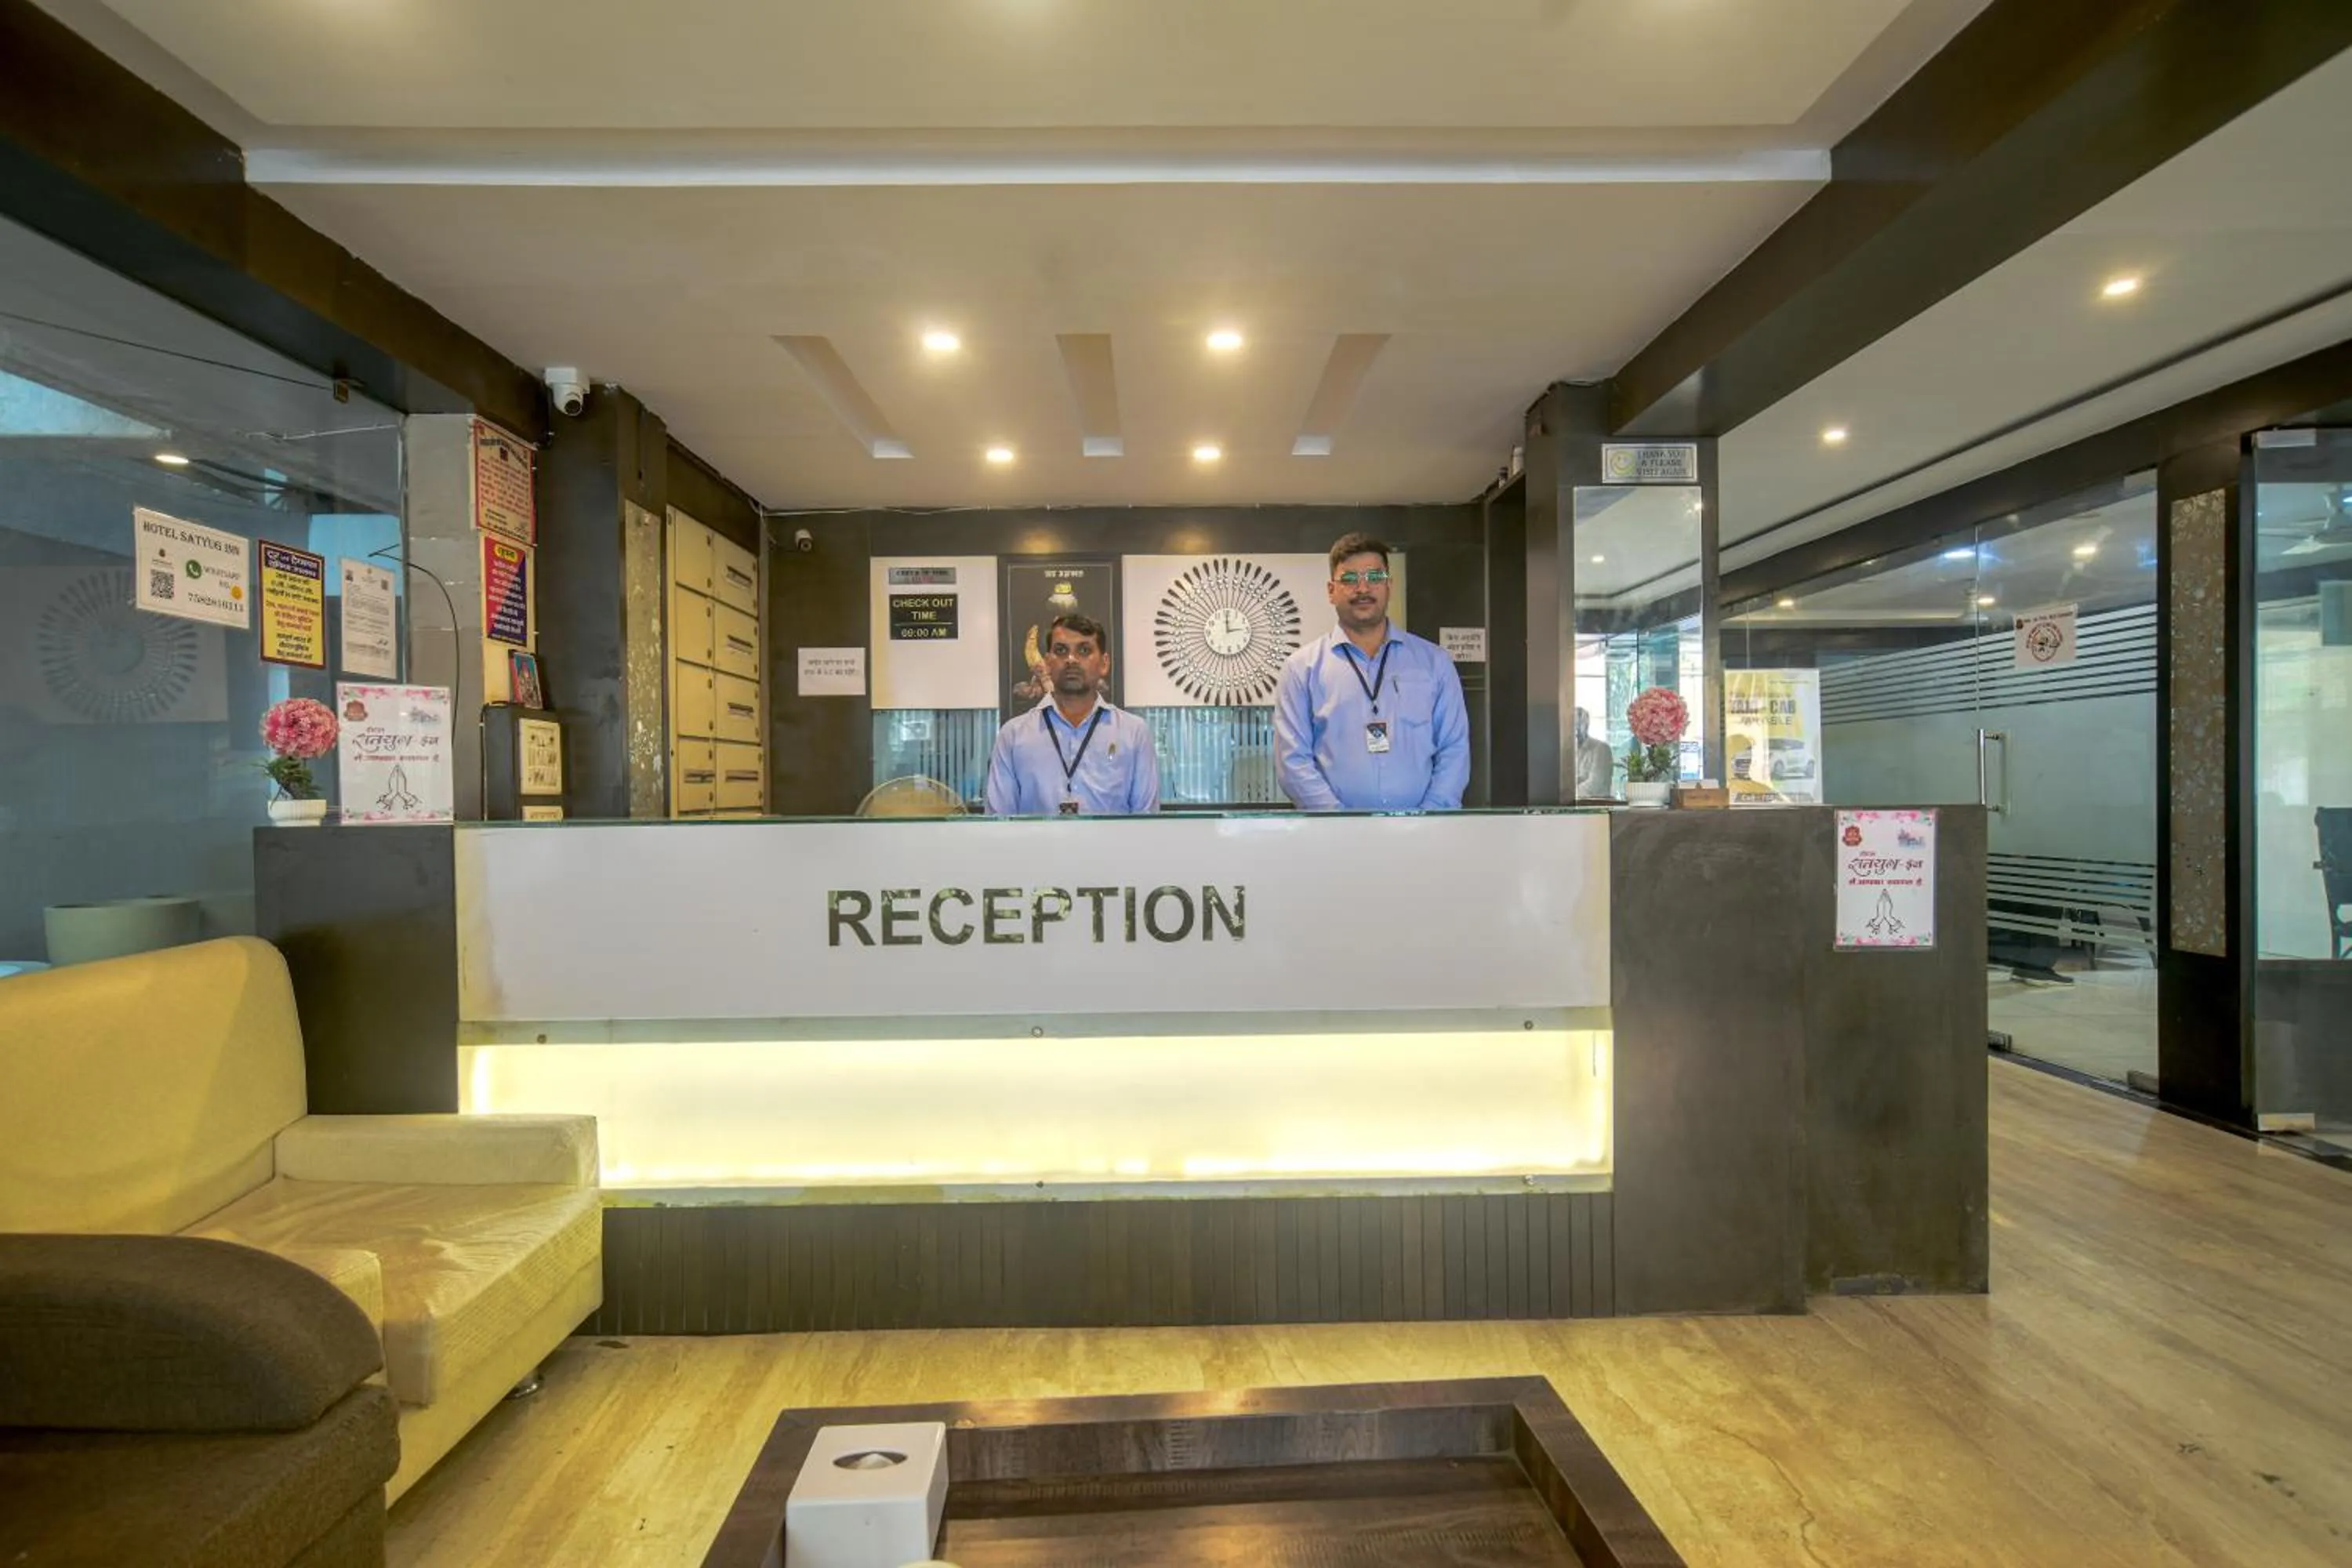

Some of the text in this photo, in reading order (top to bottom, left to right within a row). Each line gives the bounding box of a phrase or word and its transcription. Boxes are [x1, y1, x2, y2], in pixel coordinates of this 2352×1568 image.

[143, 521, 240, 556] HOTEL SATYUG INN
[893, 598, 953, 608] CHECK OUT
[911, 611, 937, 620] TIME
[931, 628, 946, 637] AM
[827, 884, 1245, 946] RECEPTION
